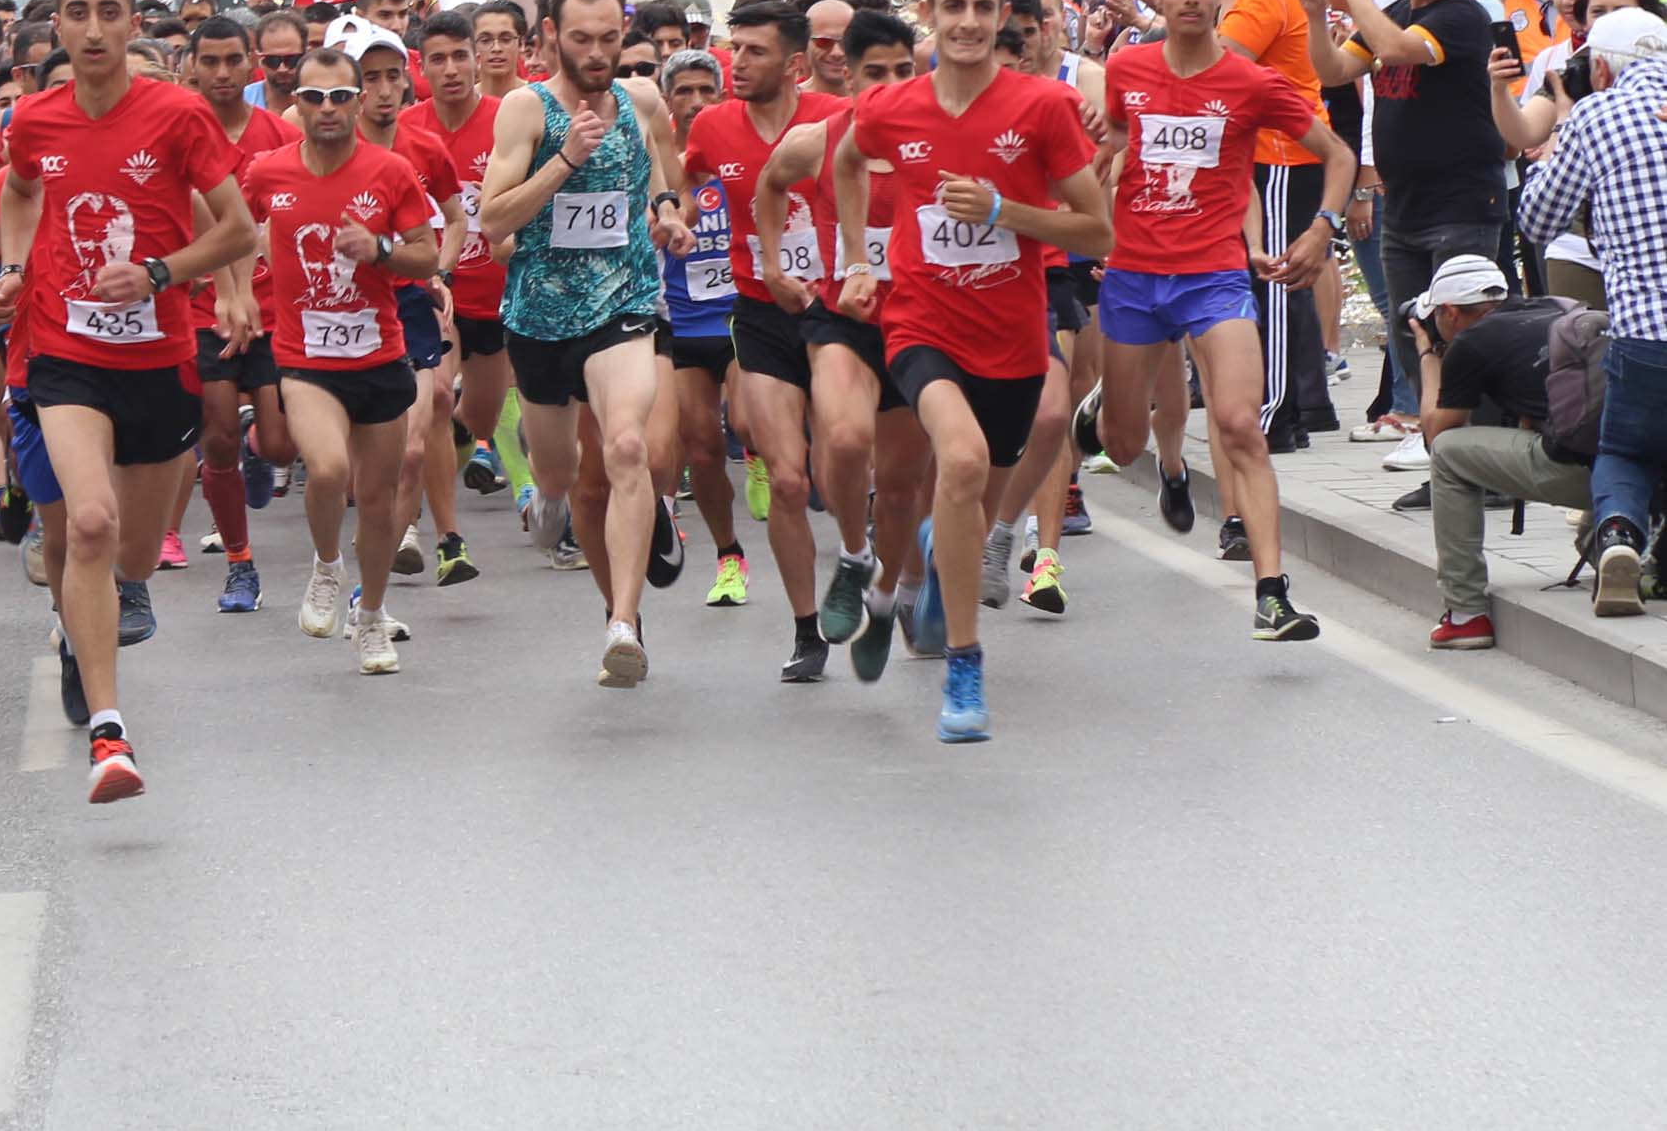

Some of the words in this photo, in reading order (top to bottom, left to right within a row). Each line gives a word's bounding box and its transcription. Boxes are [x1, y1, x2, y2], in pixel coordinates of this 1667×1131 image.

[1153, 126, 1207, 150] 408
[565, 204, 617, 230] 718
[932, 220, 997, 249] 402
[86, 310, 143, 336] 435
[317, 324, 365, 347] 737
